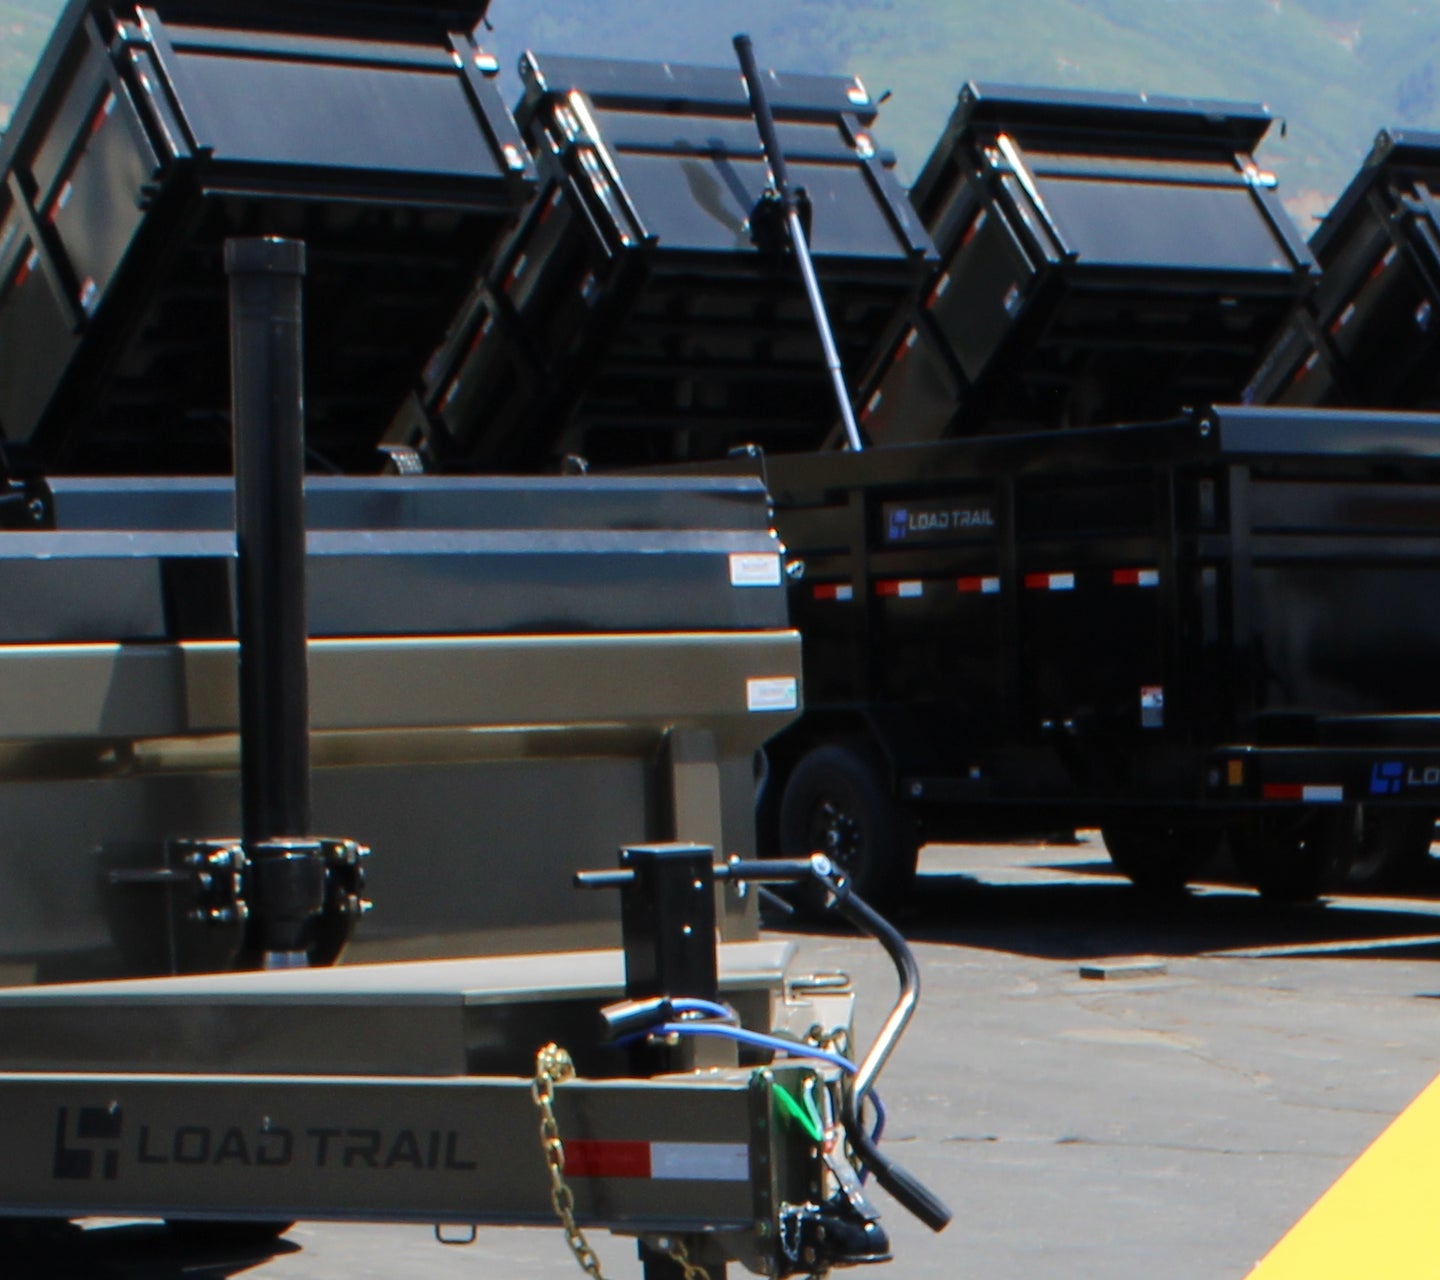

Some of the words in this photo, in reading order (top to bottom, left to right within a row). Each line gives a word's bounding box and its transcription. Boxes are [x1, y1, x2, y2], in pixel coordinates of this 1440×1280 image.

[908, 511, 950, 530] LOAD
[952, 508, 995, 528] TRAIL
[137, 1125, 295, 1167] LOAD
[305, 1127, 478, 1171] TRAIL
